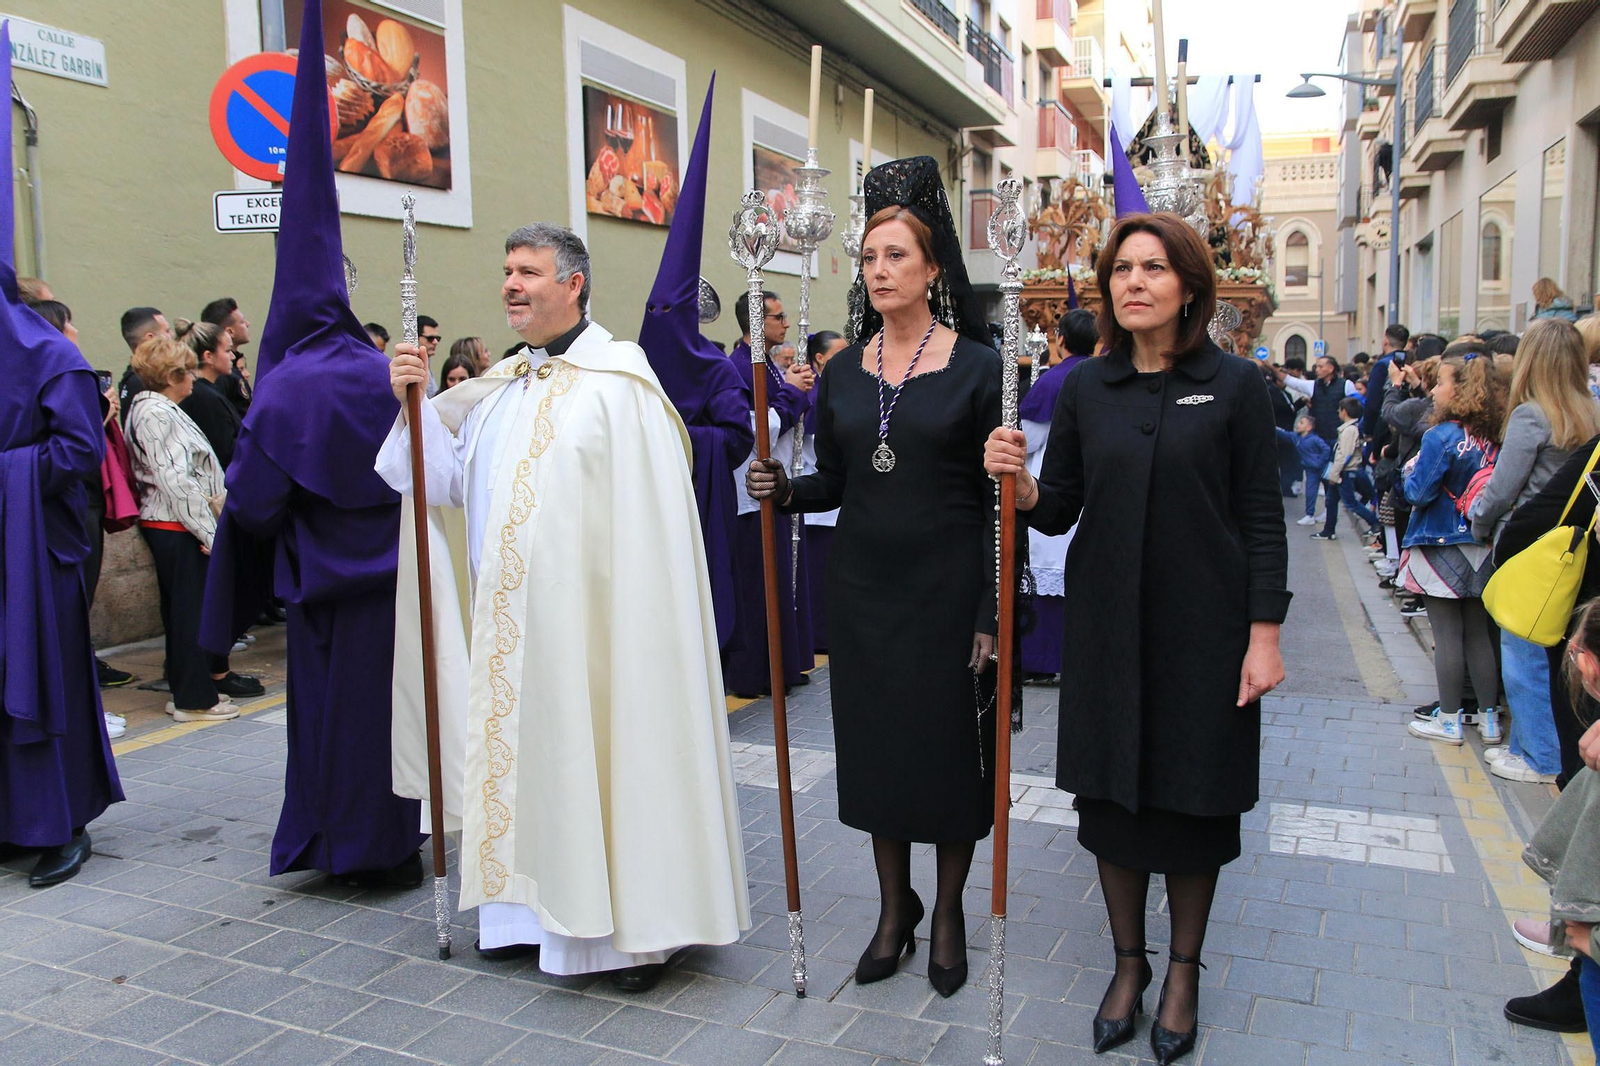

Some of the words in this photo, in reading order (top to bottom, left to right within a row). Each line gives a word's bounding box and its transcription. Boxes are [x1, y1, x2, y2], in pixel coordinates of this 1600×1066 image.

[37, 29, 75, 48] CALLE
[10, 41, 57, 69] NZÁLEZ
[229, 213, 277, 225] TEATRO
